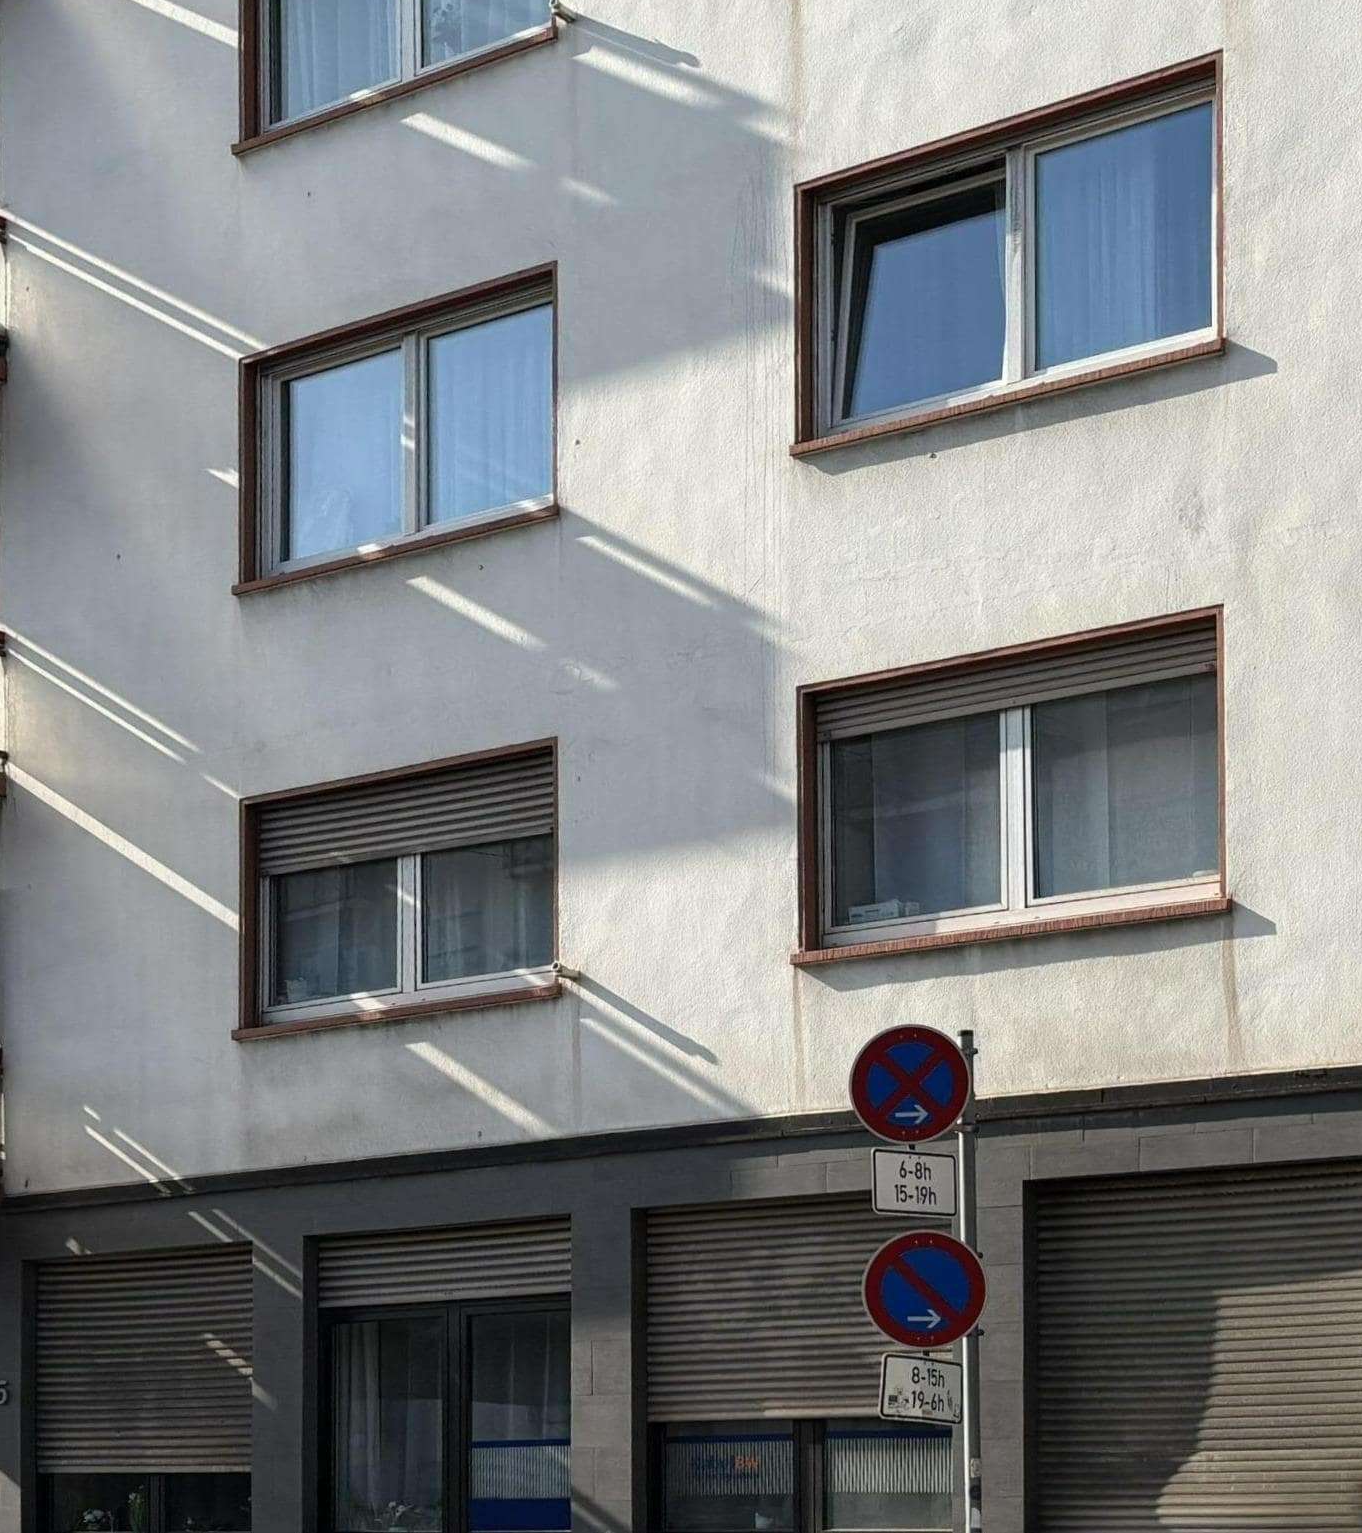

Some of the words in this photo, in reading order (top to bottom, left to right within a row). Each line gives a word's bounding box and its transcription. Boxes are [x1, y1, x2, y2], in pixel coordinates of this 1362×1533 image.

[899, 1160, 932, 1180] 6-8h
[894, 1184, 937, 1205] 15-19h
[911, 1366, 945, 1388] 8-15h
[911, 1390, 945, 1412] 19-6h
